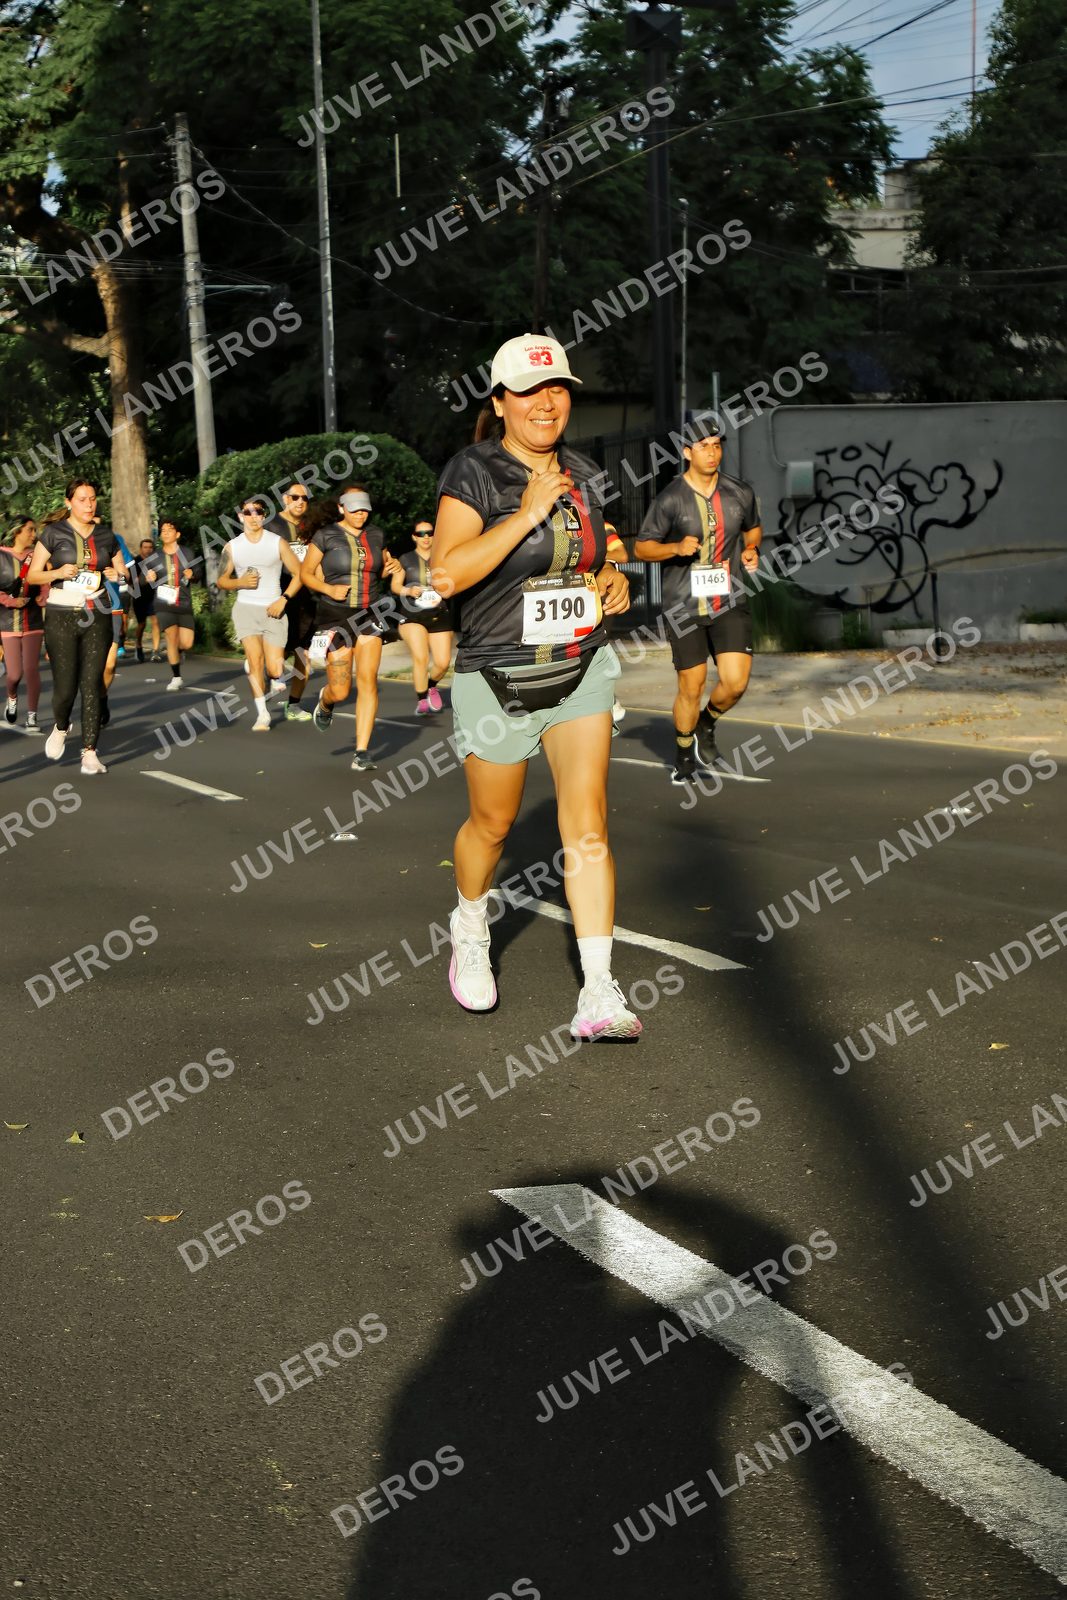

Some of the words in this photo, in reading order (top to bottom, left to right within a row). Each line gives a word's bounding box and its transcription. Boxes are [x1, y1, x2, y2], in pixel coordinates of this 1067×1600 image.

[529, 351, 553, 366] 93
[815, 440, 893, 470] TOY
[695, 573, 725, 585] 11465
[535, 596, 585, 622] 3190
